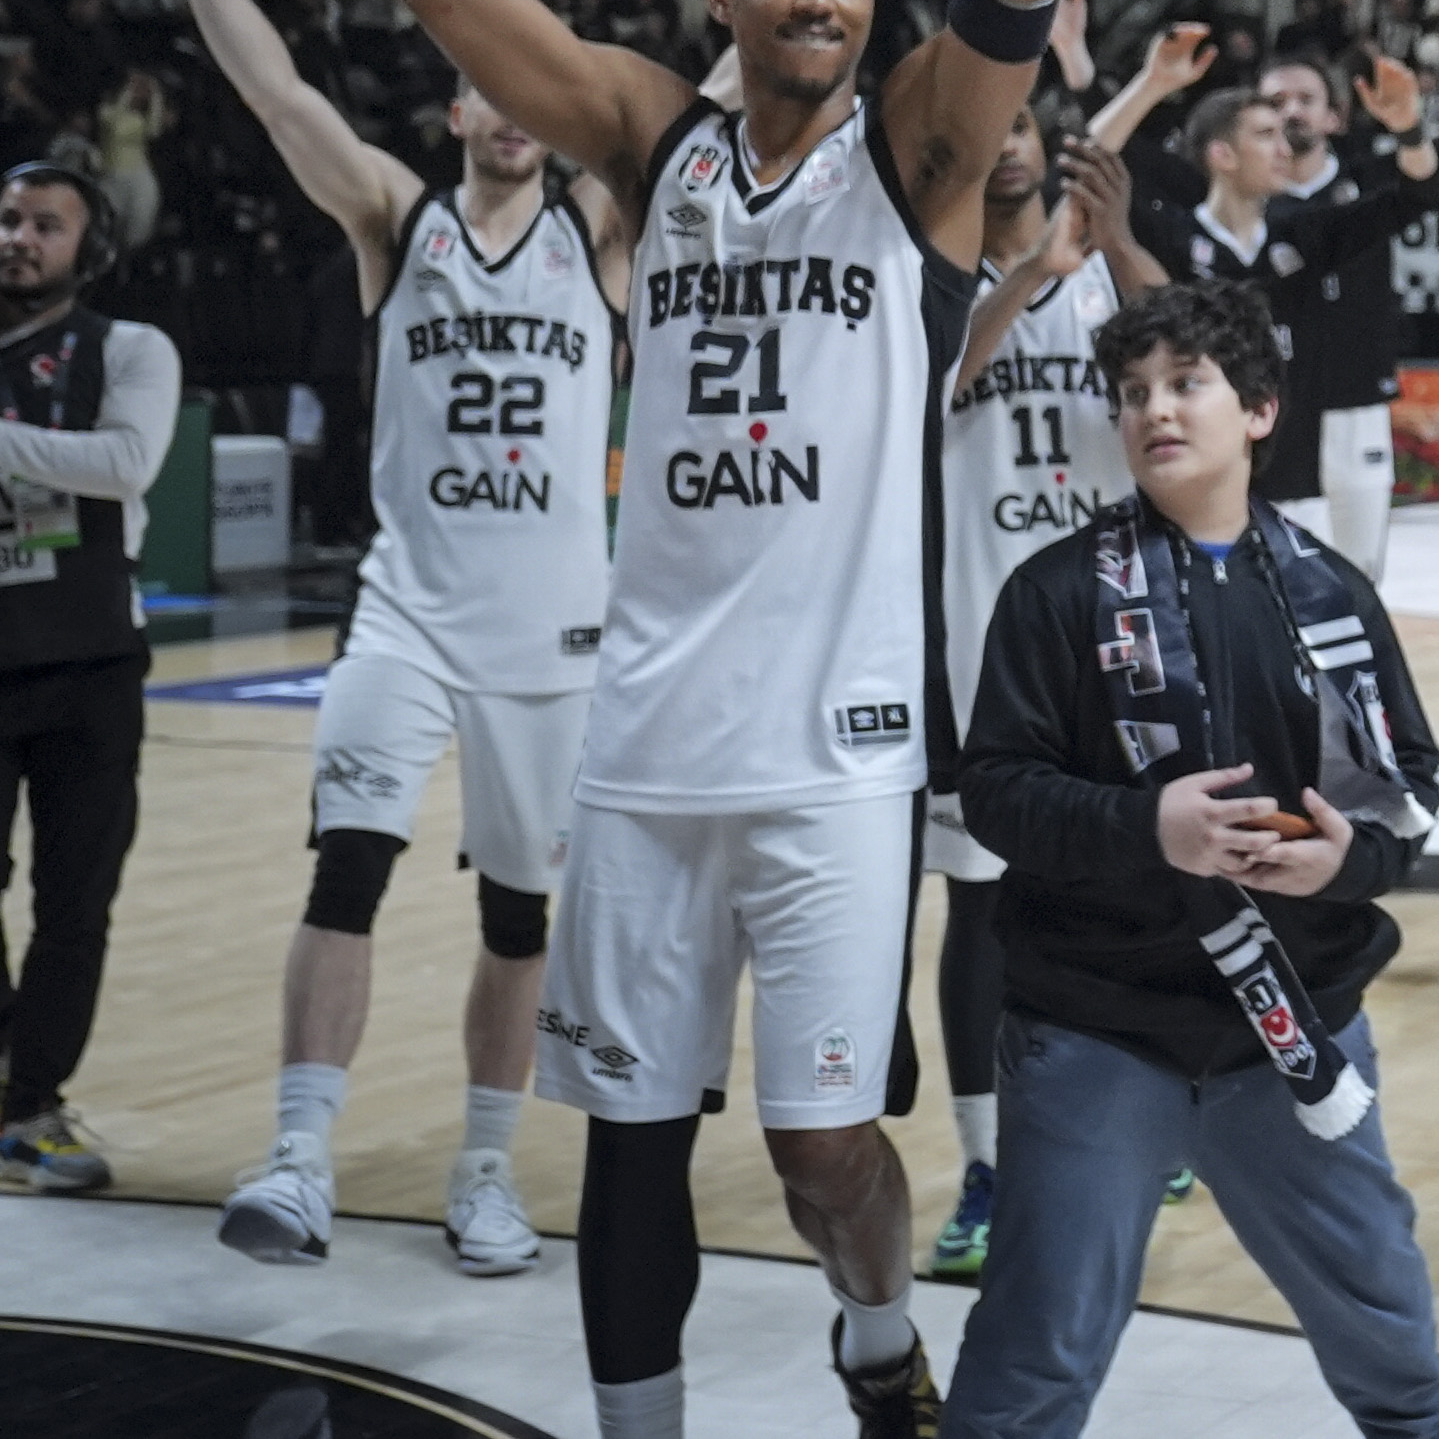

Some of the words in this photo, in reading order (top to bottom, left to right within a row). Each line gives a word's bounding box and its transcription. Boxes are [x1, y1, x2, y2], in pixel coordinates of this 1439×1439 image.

[407, 310, 587, 376] BEŞİKTAŞ
[687, 328, 787, 415] 21
[447, 371, 546, 436] 22
[1011, 404, 1071, 468] 11
